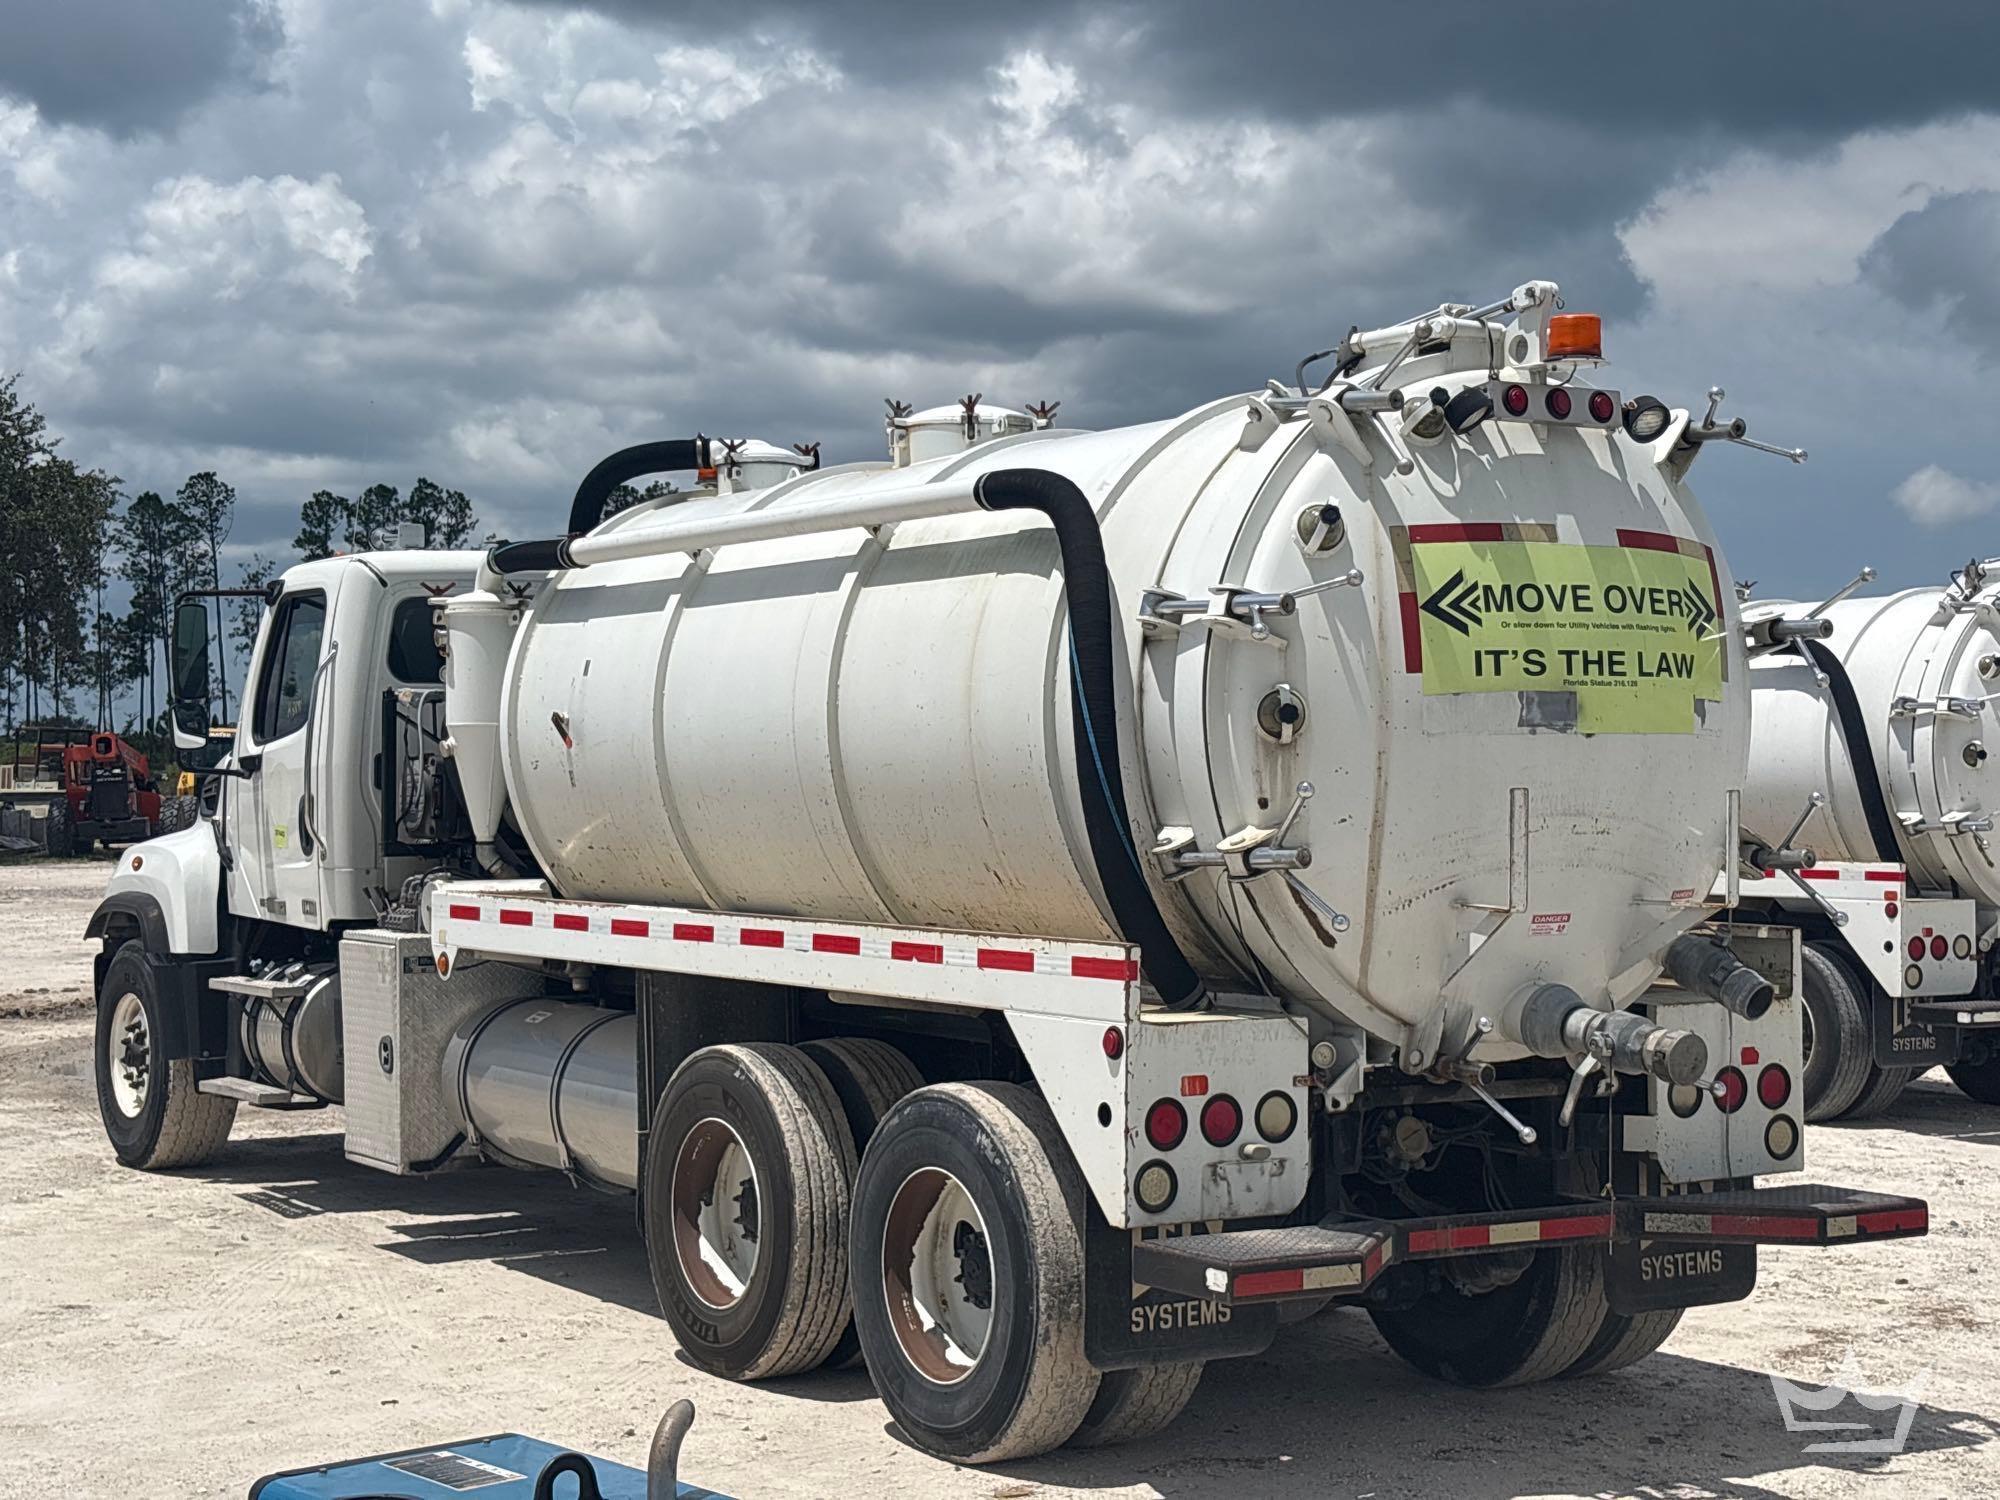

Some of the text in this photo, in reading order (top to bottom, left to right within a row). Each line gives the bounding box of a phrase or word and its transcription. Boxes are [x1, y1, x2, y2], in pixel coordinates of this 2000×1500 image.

[1482, 583, 1685, 617] MOVE OVER
[1501, 621, 1511, 629] Or
[1513, 621, 1531, 629] slow
[1533, 621, 1554, 629] down
[1556, 621, 1567, 629] for
[1569, 621, 1590, 631] Utility
[1591, 622, 1619, 630] Vehicles
[1635, 623, 1659, 633] flashing
[1474, 648, 1695, 679] IT'S THE LAW
[1563, 679, 1588, 687] Florida
[1534, 915, 1569, 923] DANGER
[1892, 1036, 1936, 1052] SYSTEMS
[1641, 1249, 1722, 1281] SYSTEMS
[1131, 1300, 1232, 1333] SYSTEMS
